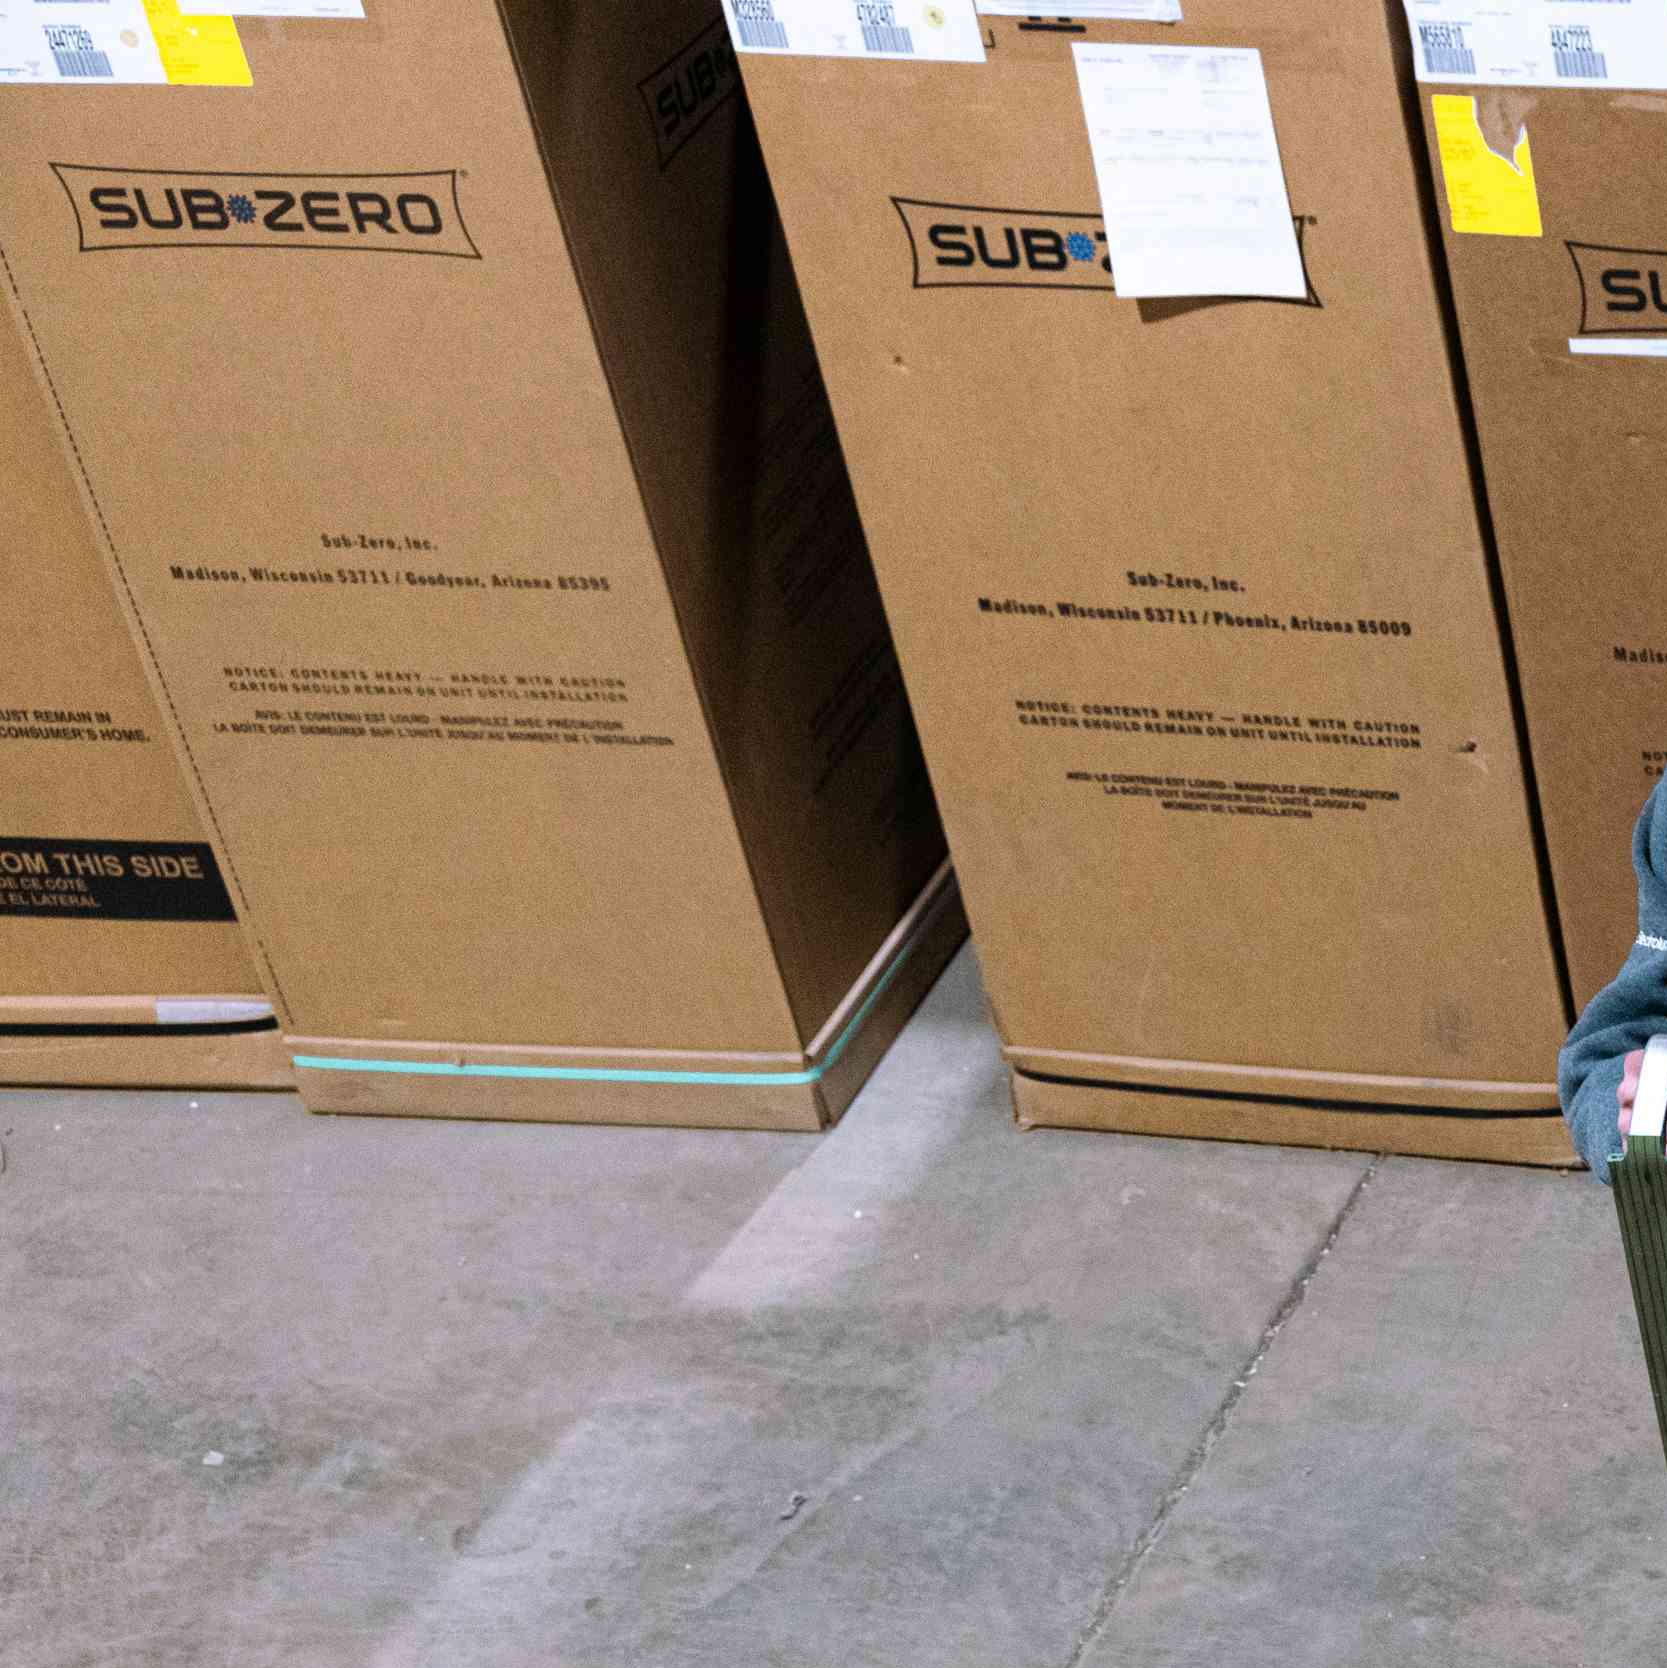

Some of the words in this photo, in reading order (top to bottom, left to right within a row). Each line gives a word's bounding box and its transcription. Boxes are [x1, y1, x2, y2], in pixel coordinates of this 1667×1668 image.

[928, 224, 1069, 272] SUB
[320, 533, 403, 551] Sub-Zero,
[404, 537, 439, 552] Inc.
[169, 565, 247, 584] Madison,
[249, 567, 334, 584] Wisconsin
[336, 569, 392, 586] 53711
[404, 570, 487, 589] Goodyear,
[491, 574, 553, 590] Arizona
[1126, 571, 1209, 593] Sub-Zero,
[1211, 576, 1246, 593] Inc.
[977, 598, 1055, 620] Madison,
[1056, 602, 1141, 622] Wisconsin
[1143, 606, 1198, 626] 53711
[1212, 611, 1287, 634] Phoenix,
[1289, 615, 1354, 635] Arizona
[1357, 619, 1413, 638] 85009
[33, 709, 92, 723] REMAIN
[95, 711, 112, 724] IN
[1081, 704, 1159, 720] CONTENTS
[1166, 709, 1214, 722] HEAVY
[1242, 713, 1300, 728] HANDLE
[1308, 718, 1348, 731] WITH
[1353, 720, 1421, 735] CAUTION
[99, 728, 150, 743] HOME.
[1018, 713, 1080, 729] CARTON
[1082, 717, 1142, 733] SHOULD
[1144, 721, 1204, 736] REMAIN
[1206, 725, 1227, 738] ON
[1229, 727, 1266, 740] UNIT
[1267, 730, 1313, 743] UNTIL
[1315, 733, 1422, 750] INSTALLATION
[0, 851, 50, 875] OM
[52, 852, 124, 877] THIS
[130, 853, 204, 880] SIDE
